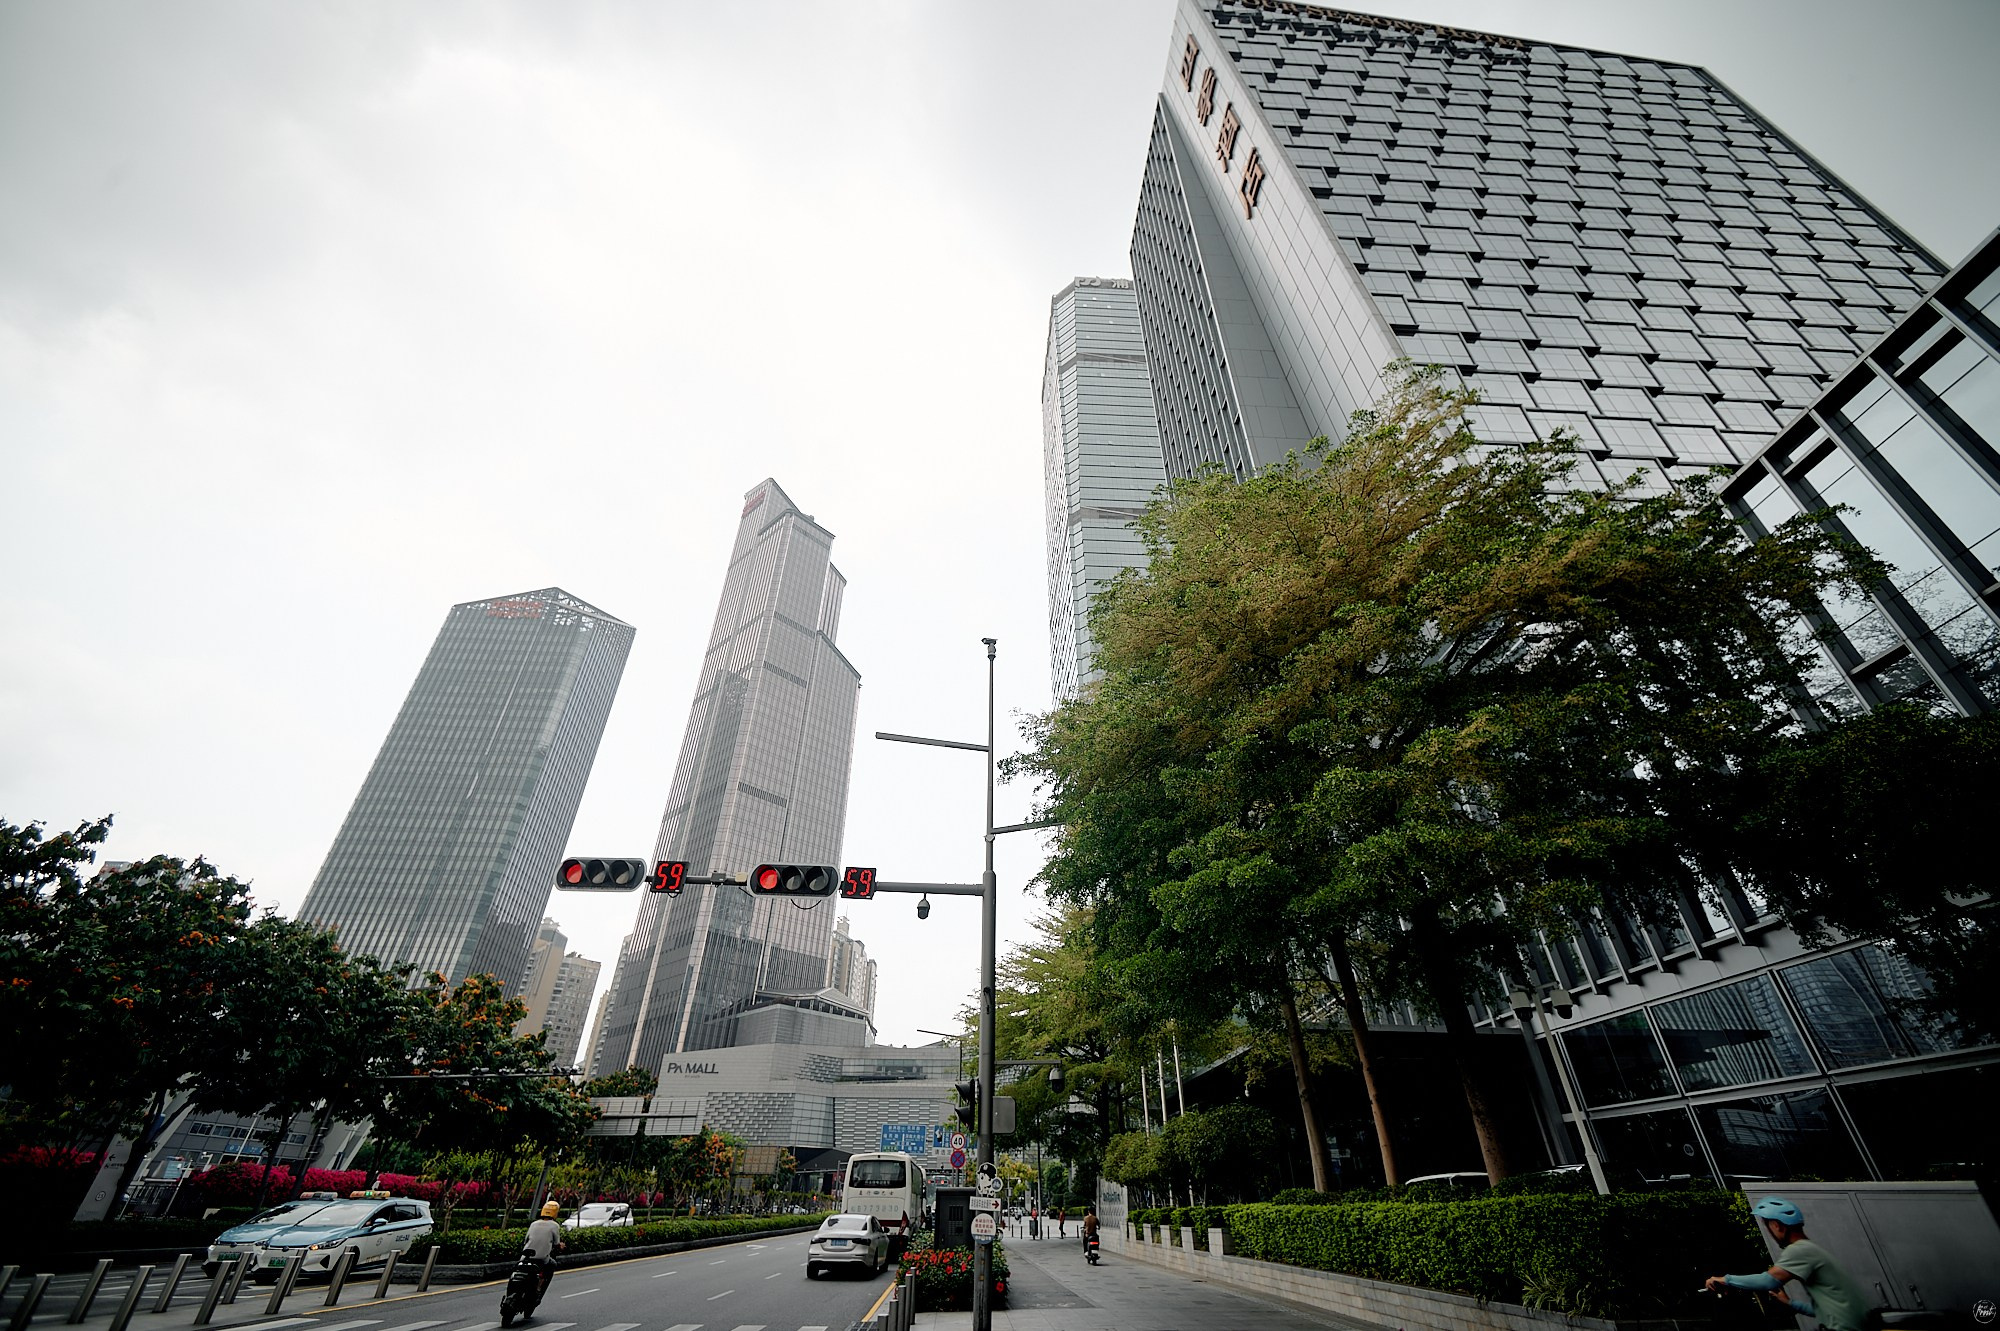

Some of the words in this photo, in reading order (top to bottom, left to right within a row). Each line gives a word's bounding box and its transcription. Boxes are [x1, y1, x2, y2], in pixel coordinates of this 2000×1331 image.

[1222, 0, 1299, 13] OUR
[656, 863, 683, 889] 59
[847, 868, 872, 896] 59
[685, 1063, 719, 1074] MALL
[953, 1137, 962, 1146] 40
